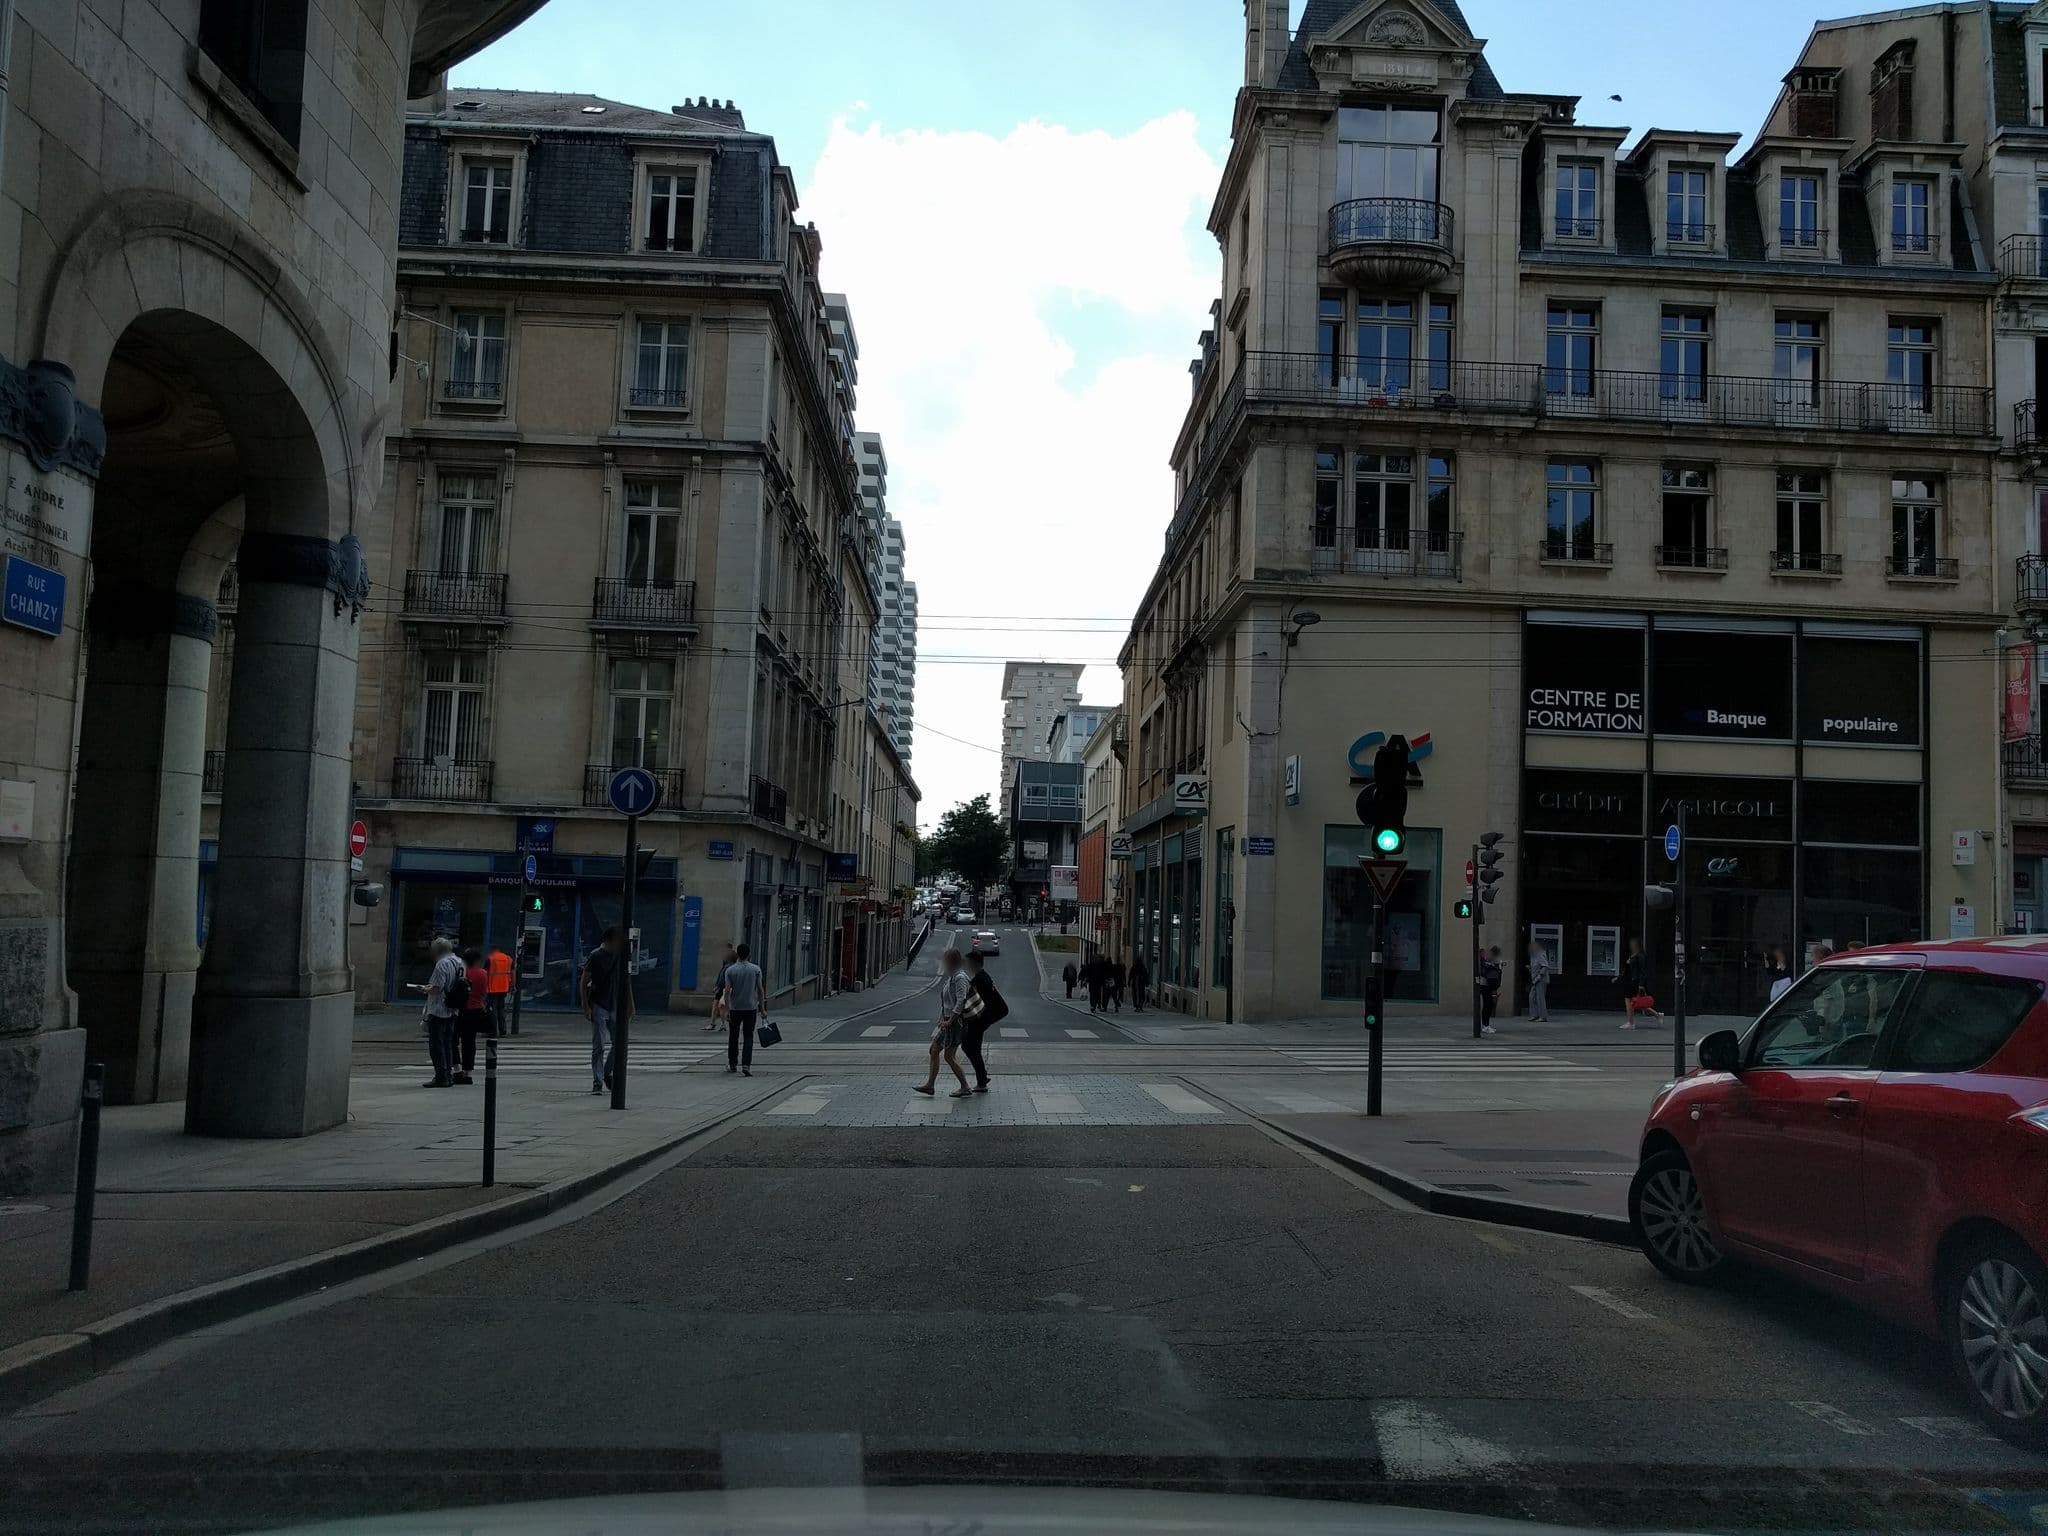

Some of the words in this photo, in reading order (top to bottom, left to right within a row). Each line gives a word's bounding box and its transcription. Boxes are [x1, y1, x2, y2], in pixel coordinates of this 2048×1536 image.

[26, 573, 47, 592] RUE
[10, 592, 58, 625] CHANZY
[1529, 688, 1607, 708] CENTRE
[1615, 692, 1641, 710] DE
[1526, 709, 1643, 731] FORMATION
[1706, 709, 1768, 729] Banque
[1823, 716, 1899, 734] populaire
[528, 877, 578, 888] POPULAIRE
